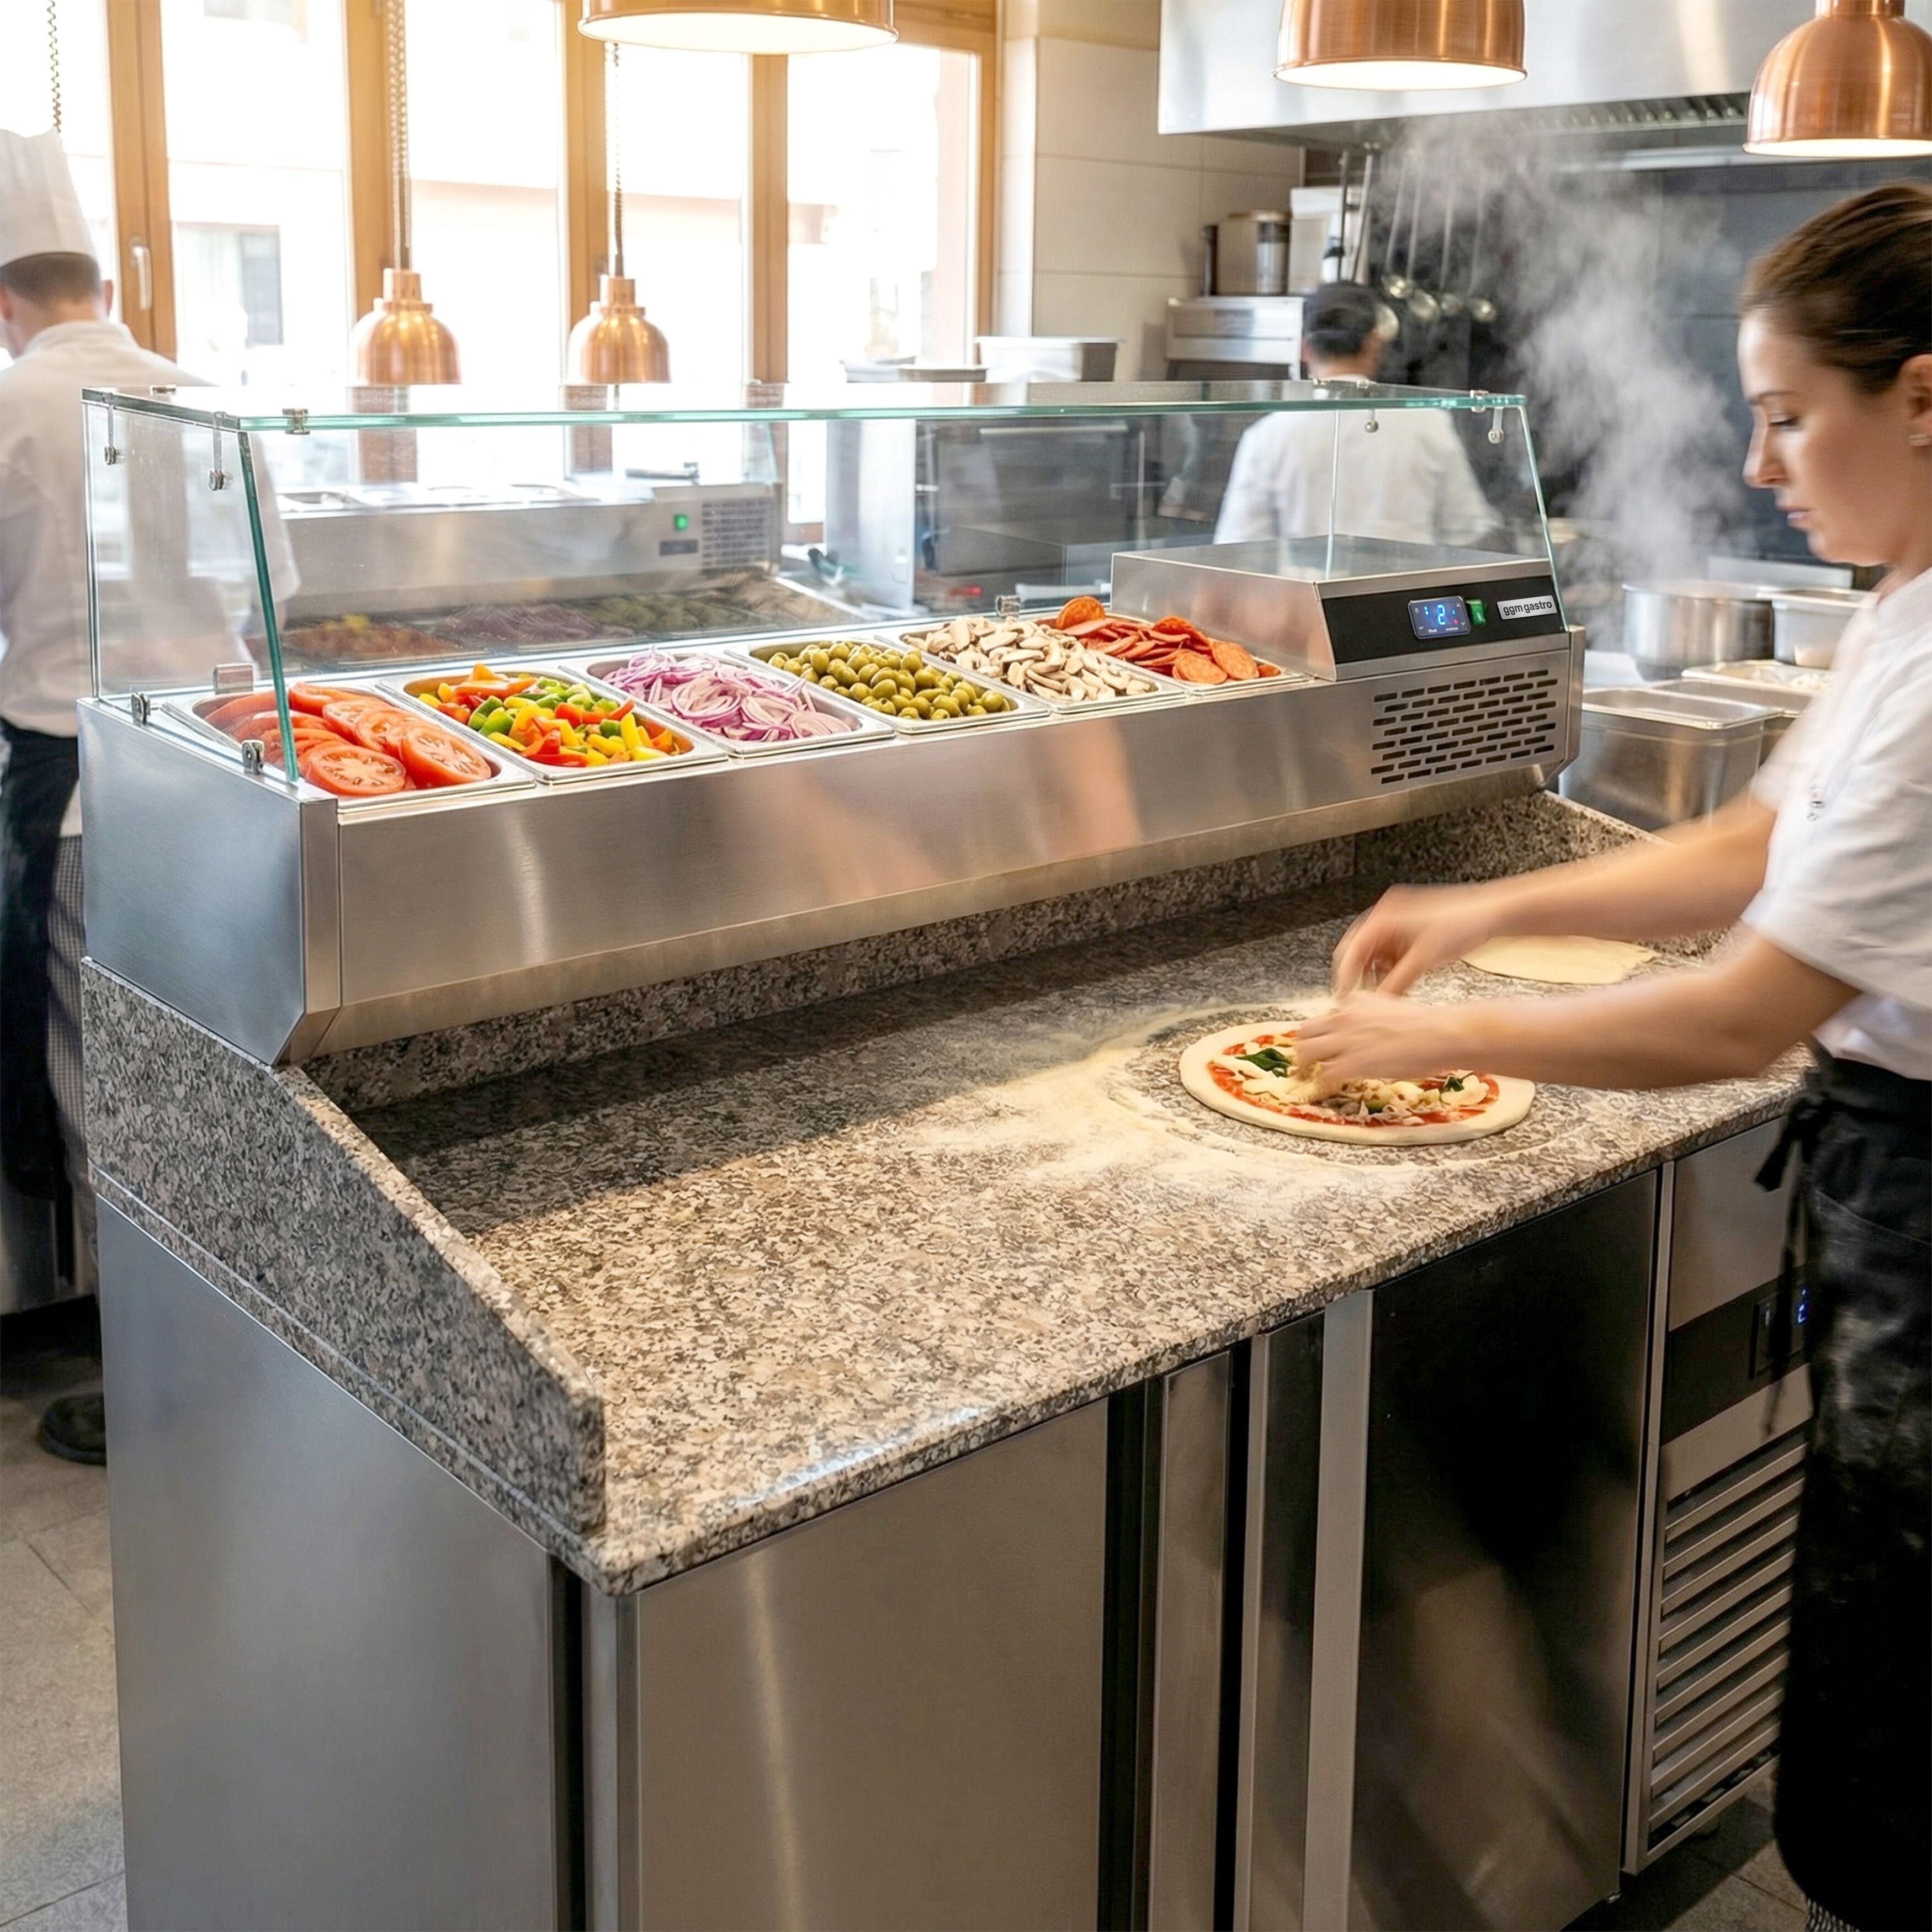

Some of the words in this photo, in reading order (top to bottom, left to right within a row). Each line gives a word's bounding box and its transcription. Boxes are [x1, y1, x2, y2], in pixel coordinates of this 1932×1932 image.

[1437, 604, 1446, 625] 2
[1503, 605, 1524, 616] ggm
[1524, 601, 1552, 613] gastro
